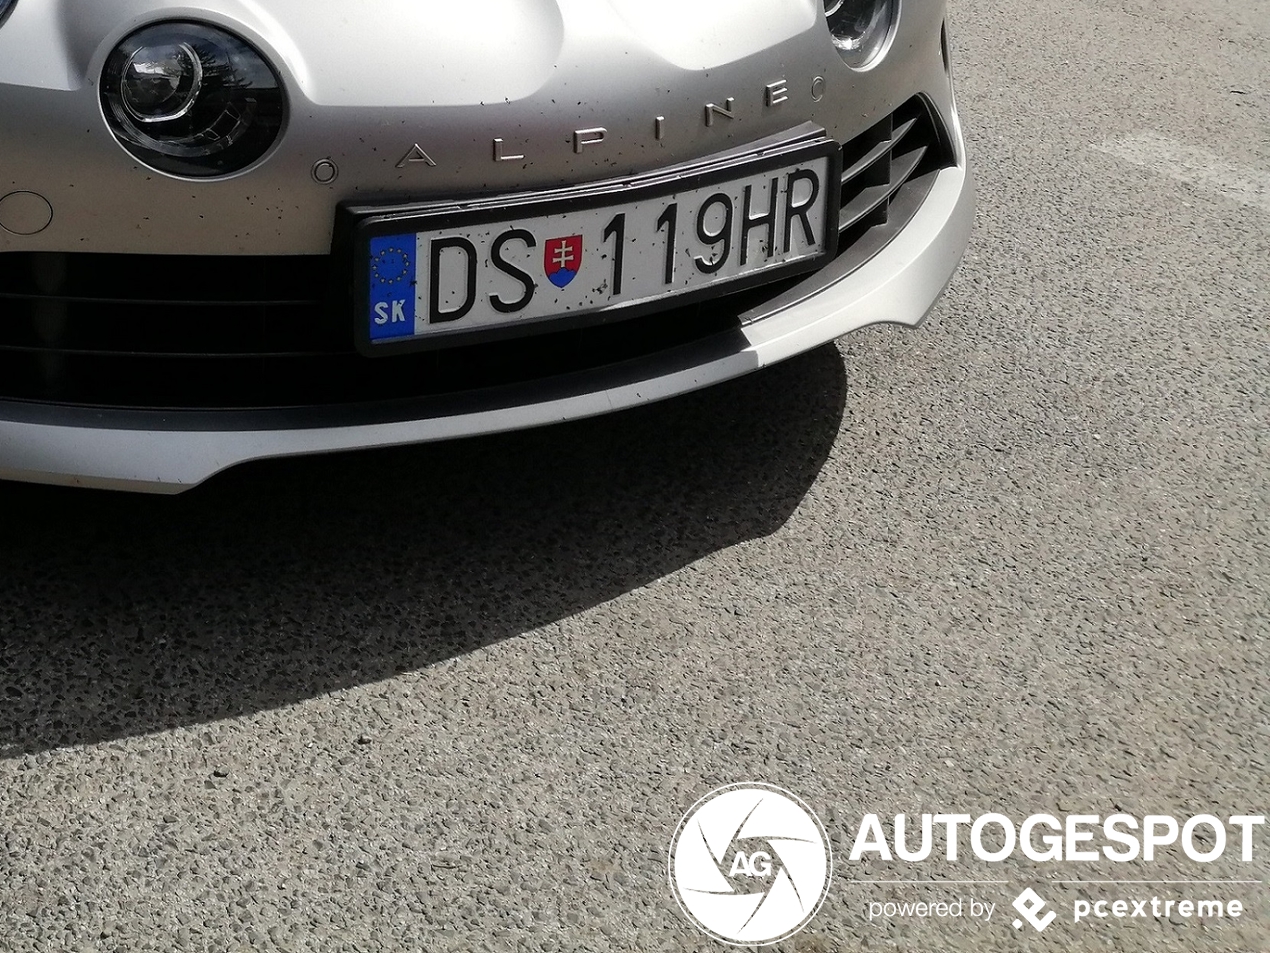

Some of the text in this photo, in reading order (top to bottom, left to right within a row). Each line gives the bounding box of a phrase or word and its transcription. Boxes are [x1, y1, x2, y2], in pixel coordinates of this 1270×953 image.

[395, 79, 788, 168] ALPINE
[430, 168, 820, 324] DS 119HR
[374, 299, 406, 325] SK
